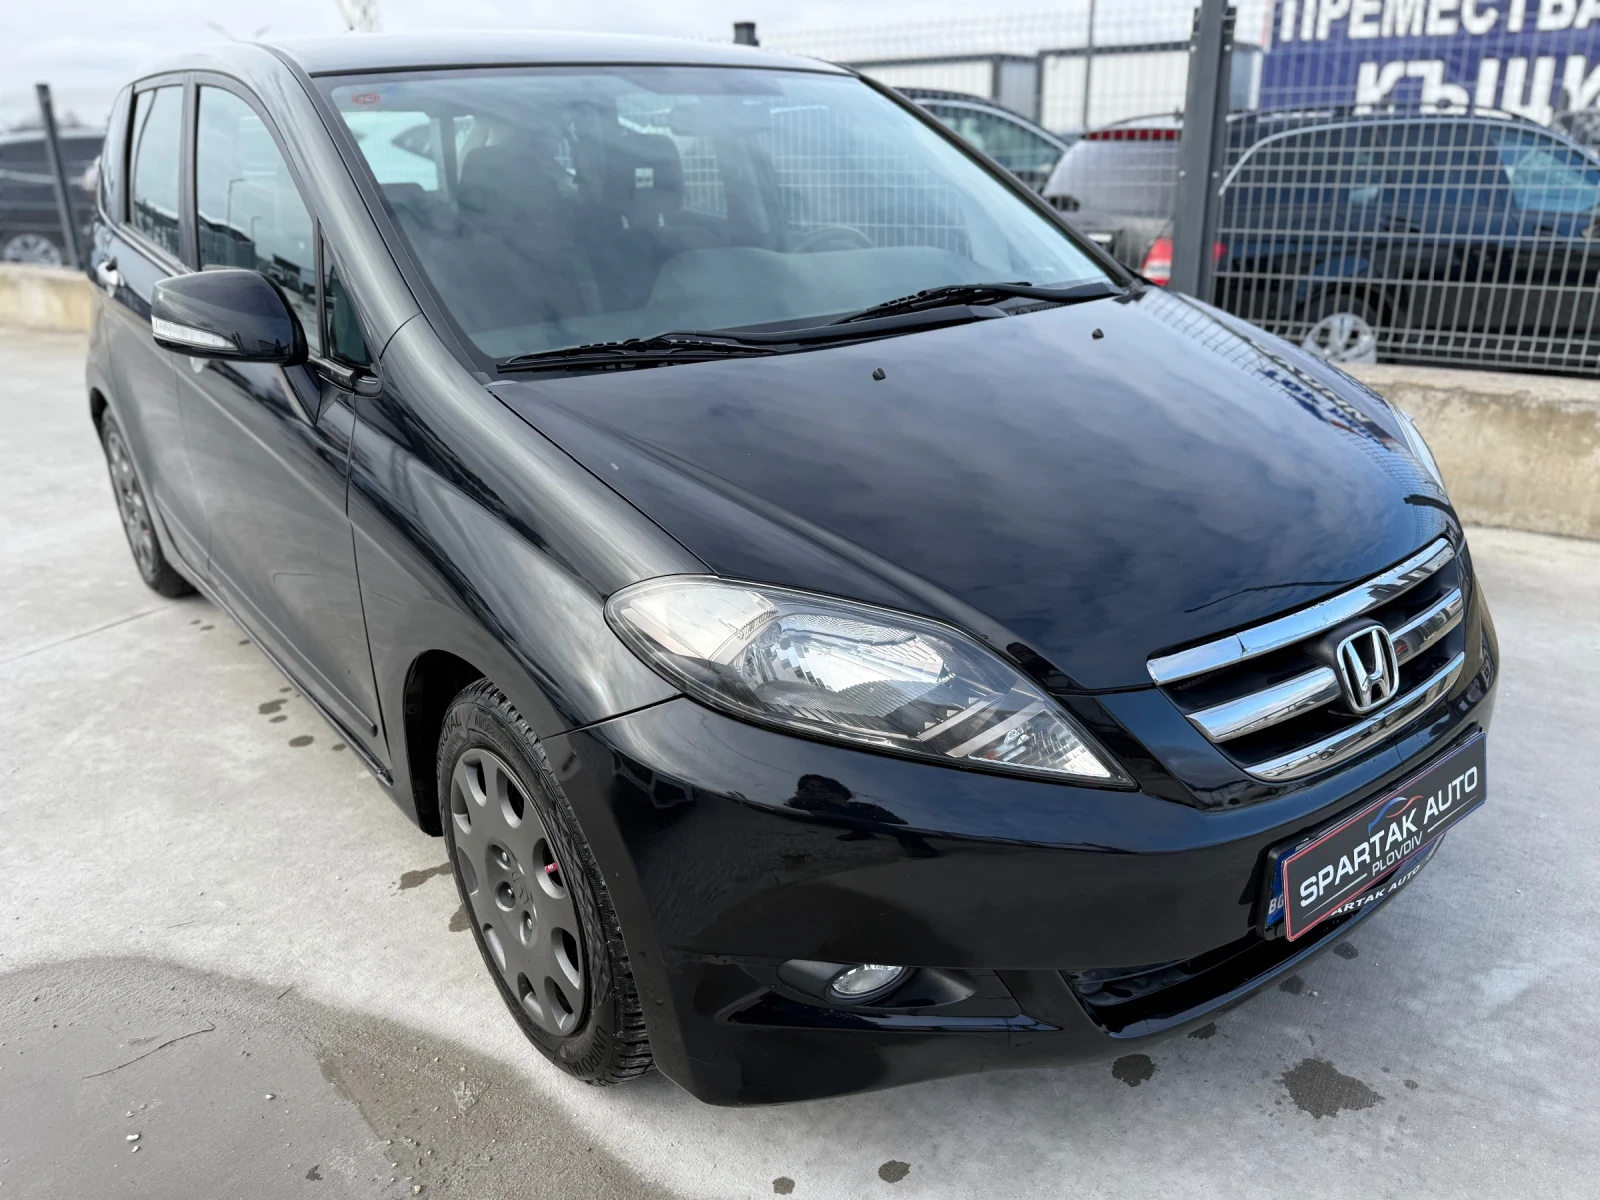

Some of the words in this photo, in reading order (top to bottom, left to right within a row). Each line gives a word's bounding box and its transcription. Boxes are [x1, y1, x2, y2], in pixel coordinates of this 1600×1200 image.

[1299, 807, 1418, 908] SPARTAK
[1423, 766, 1479, 825] AUTO
[1372, 830, 1423, 877] PLOVDIV
[1388, 864, 1421, 893] AUTO
[563, 1024, 608, 1077] UNIROYAL
